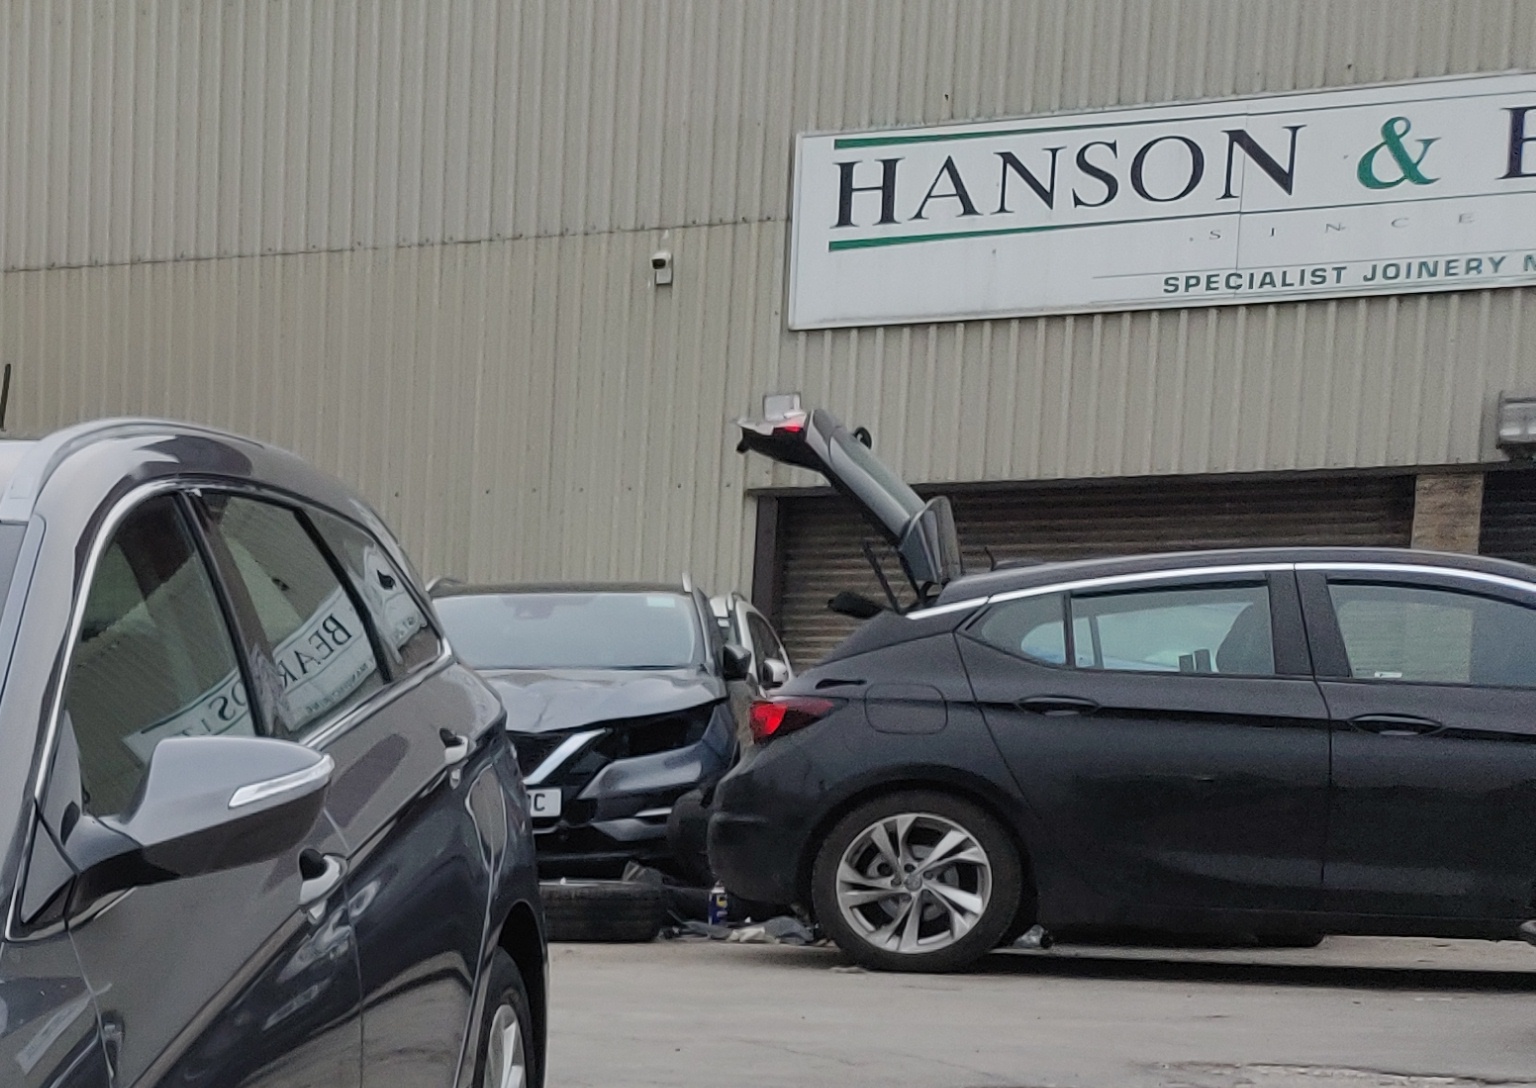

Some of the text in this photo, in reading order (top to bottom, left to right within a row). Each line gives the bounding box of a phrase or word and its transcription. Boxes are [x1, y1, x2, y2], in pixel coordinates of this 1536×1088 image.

[829, 125, 1307, 229] HANSON
[1357, 116, 1442, 190] &
[1163, 264, 1348, 294] SPECIALIST
[1363, 255, 1506, 283] JOINERY
